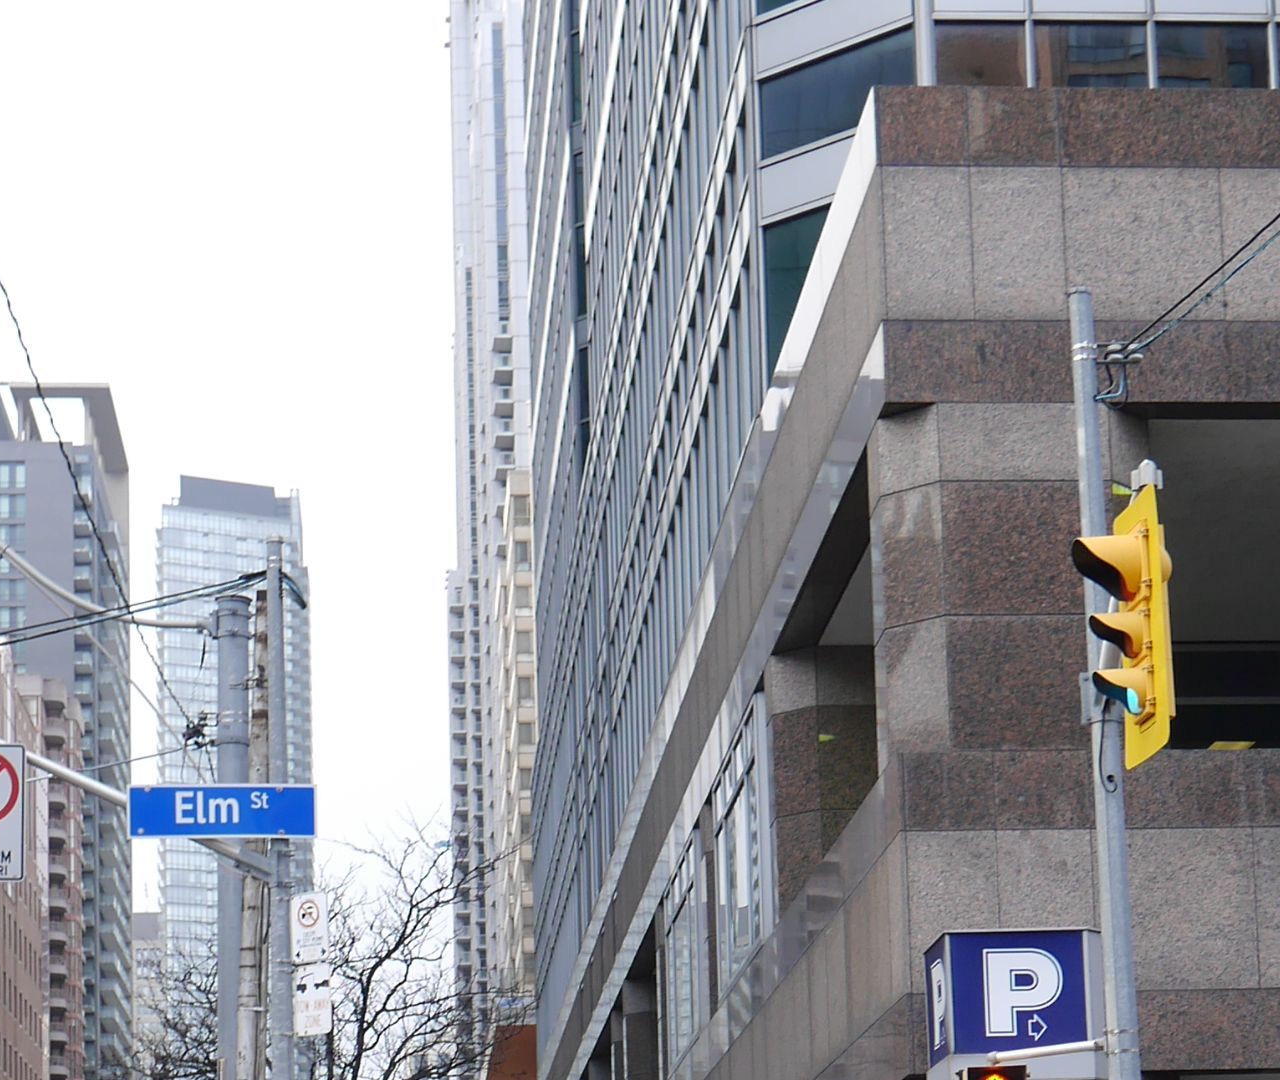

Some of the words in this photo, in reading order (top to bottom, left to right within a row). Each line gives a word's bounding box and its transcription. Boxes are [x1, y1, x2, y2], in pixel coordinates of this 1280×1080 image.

[175, 791, 240, 824] Elm
[250, 791, 269, 809] St
[982, 948, 1063, 1037] P
